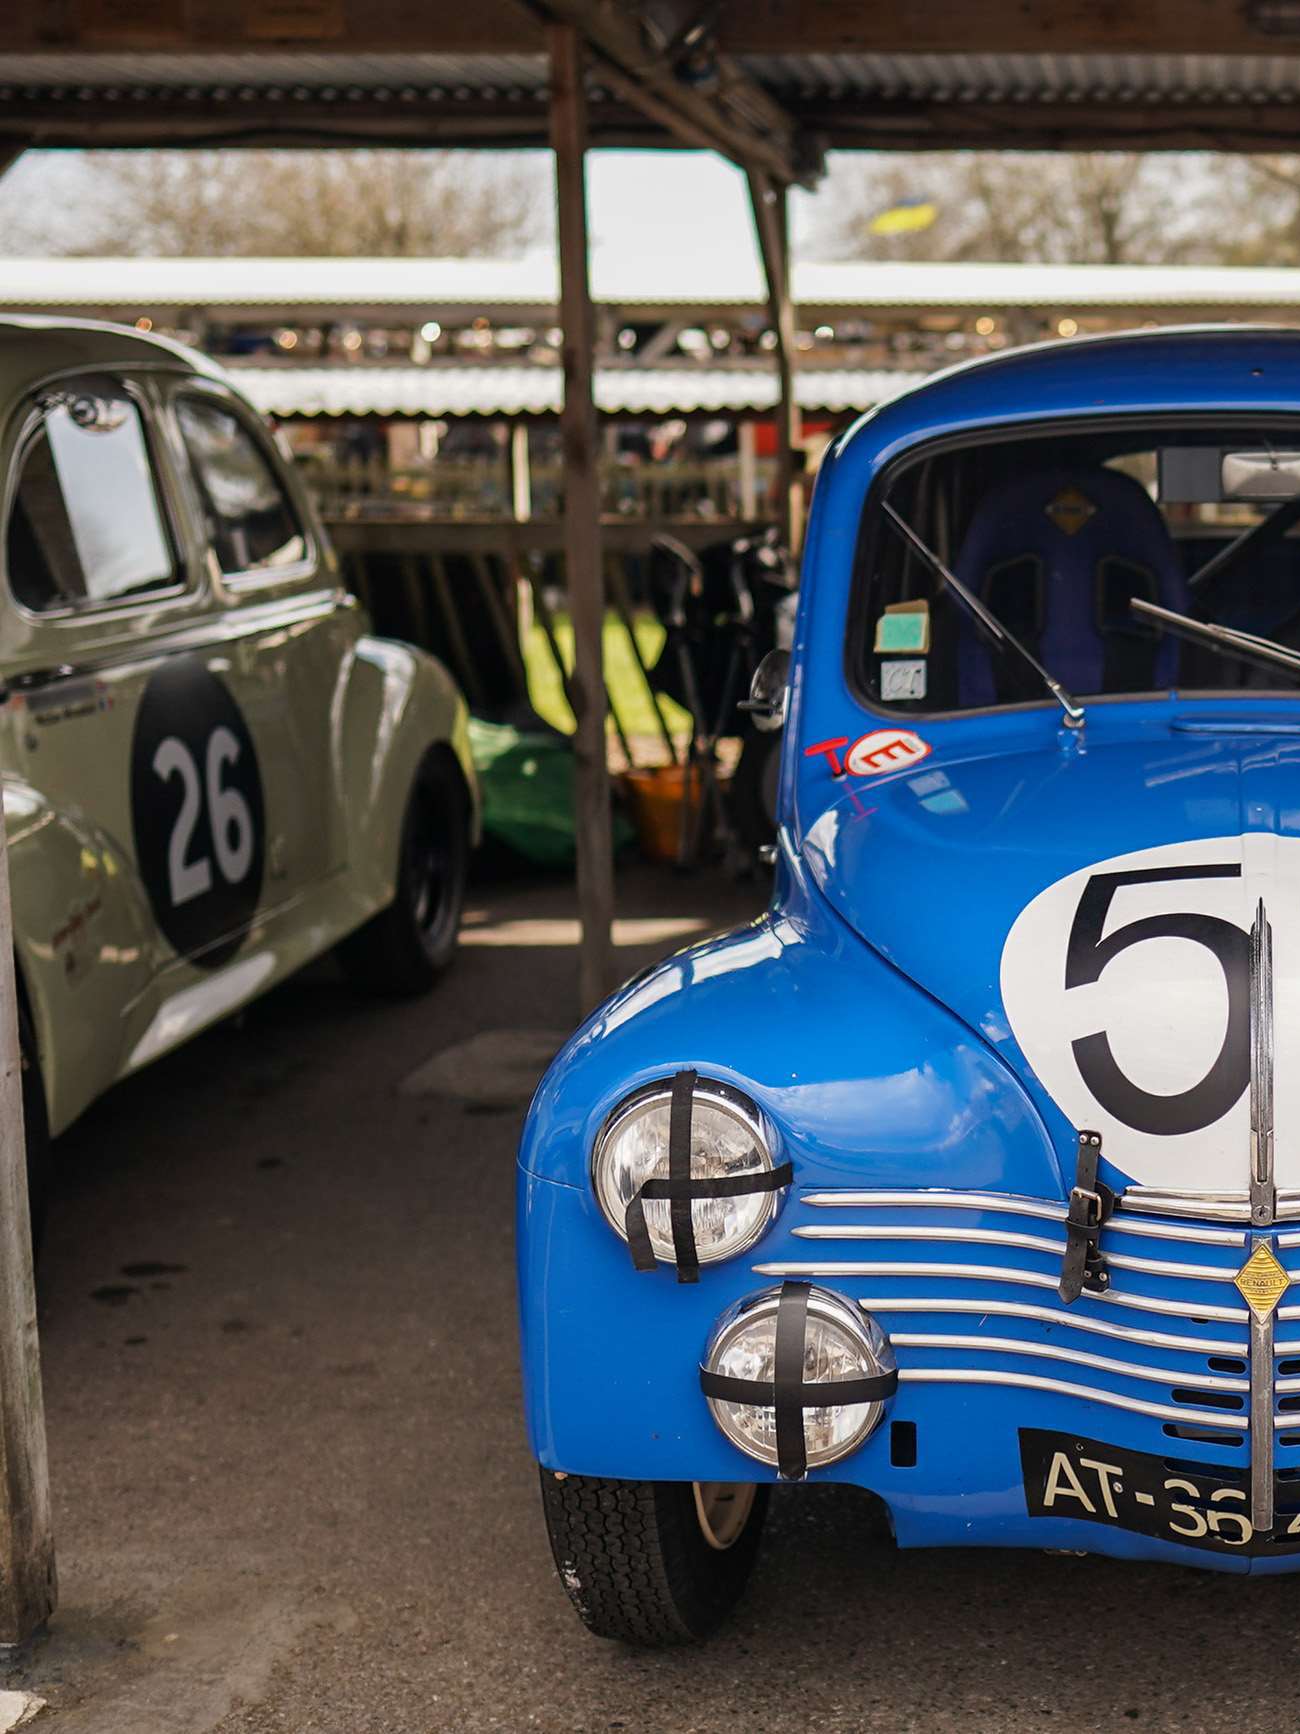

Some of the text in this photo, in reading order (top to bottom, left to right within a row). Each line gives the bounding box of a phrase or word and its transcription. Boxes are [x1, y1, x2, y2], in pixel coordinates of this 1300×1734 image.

[861, 739, 916, 769] E
[153, 725, 253, 905] 26
[1240, 1278, 1283, 1287] RENAULT
